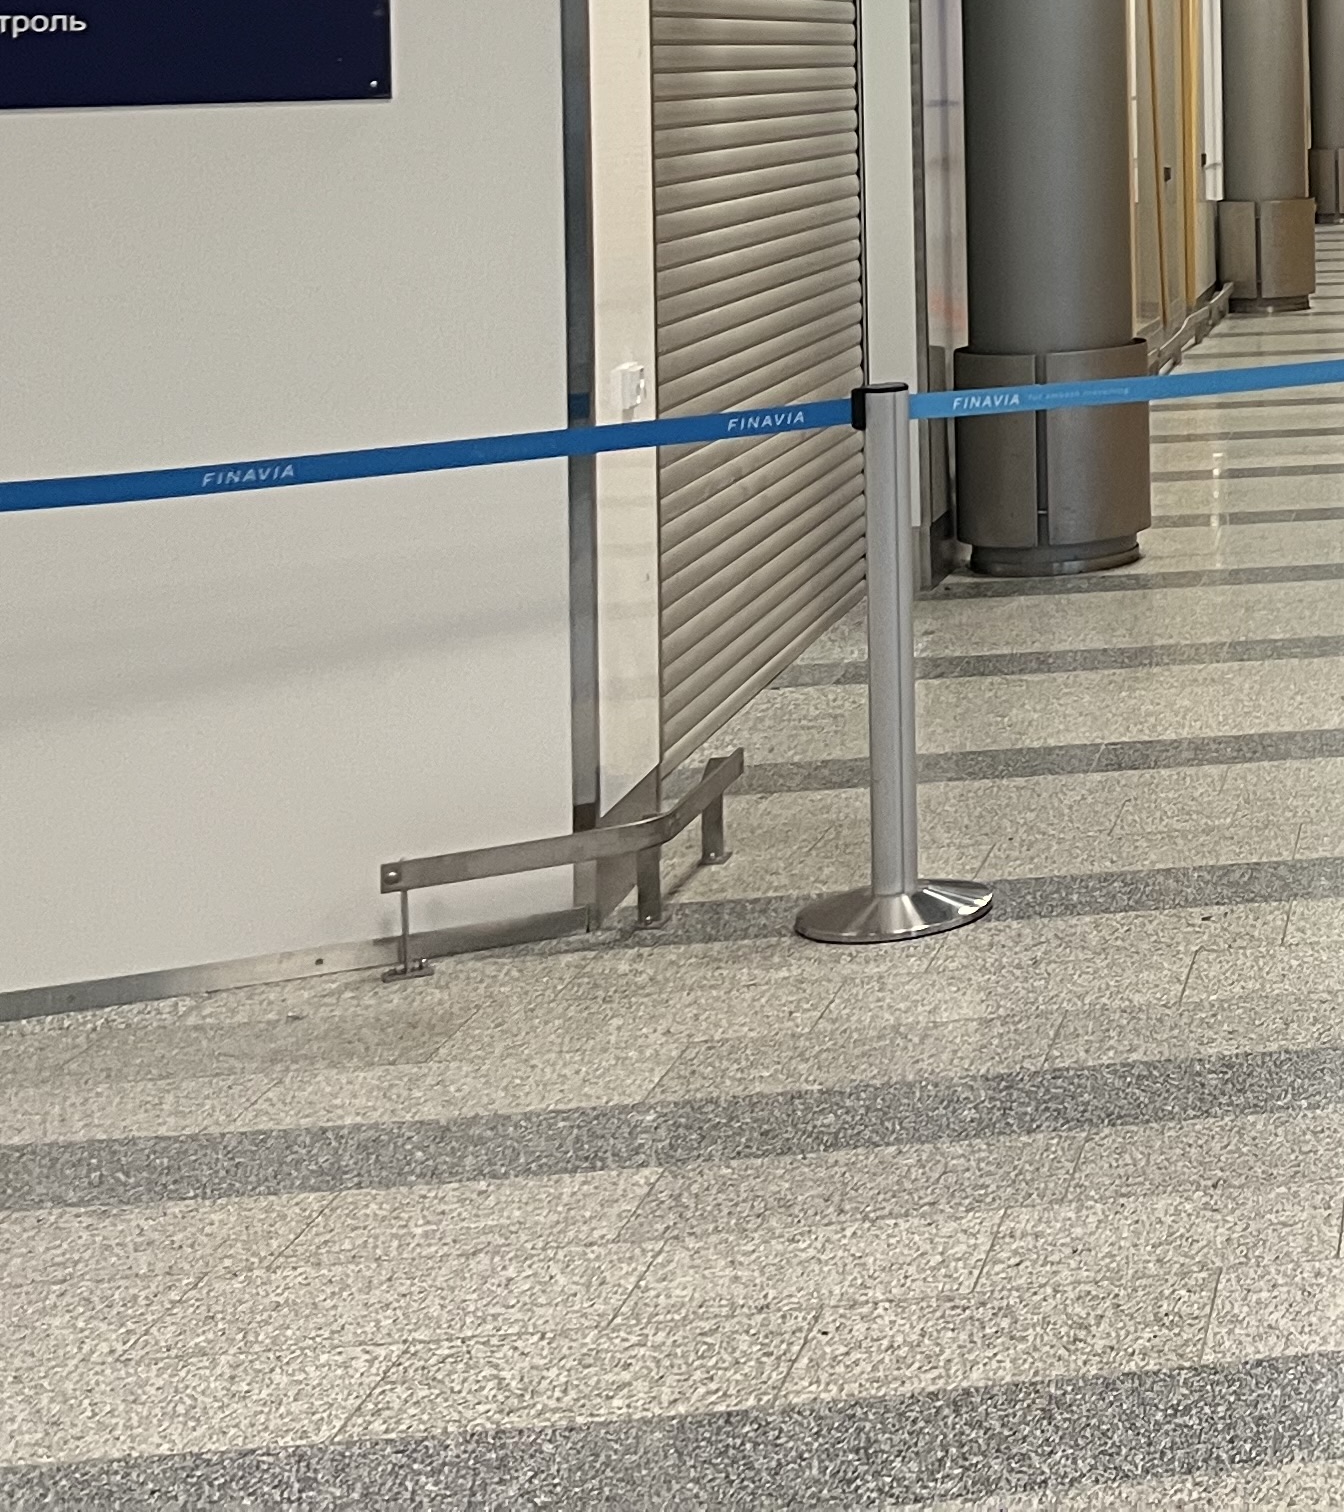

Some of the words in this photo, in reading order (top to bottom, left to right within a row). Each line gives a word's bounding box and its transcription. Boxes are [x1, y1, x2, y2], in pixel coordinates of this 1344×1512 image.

[952, 393, 1020, 410] FINAVIA
[727, 411, 805, 432] FINAVIA
[201, 464, 295, 487] FINAVIA
